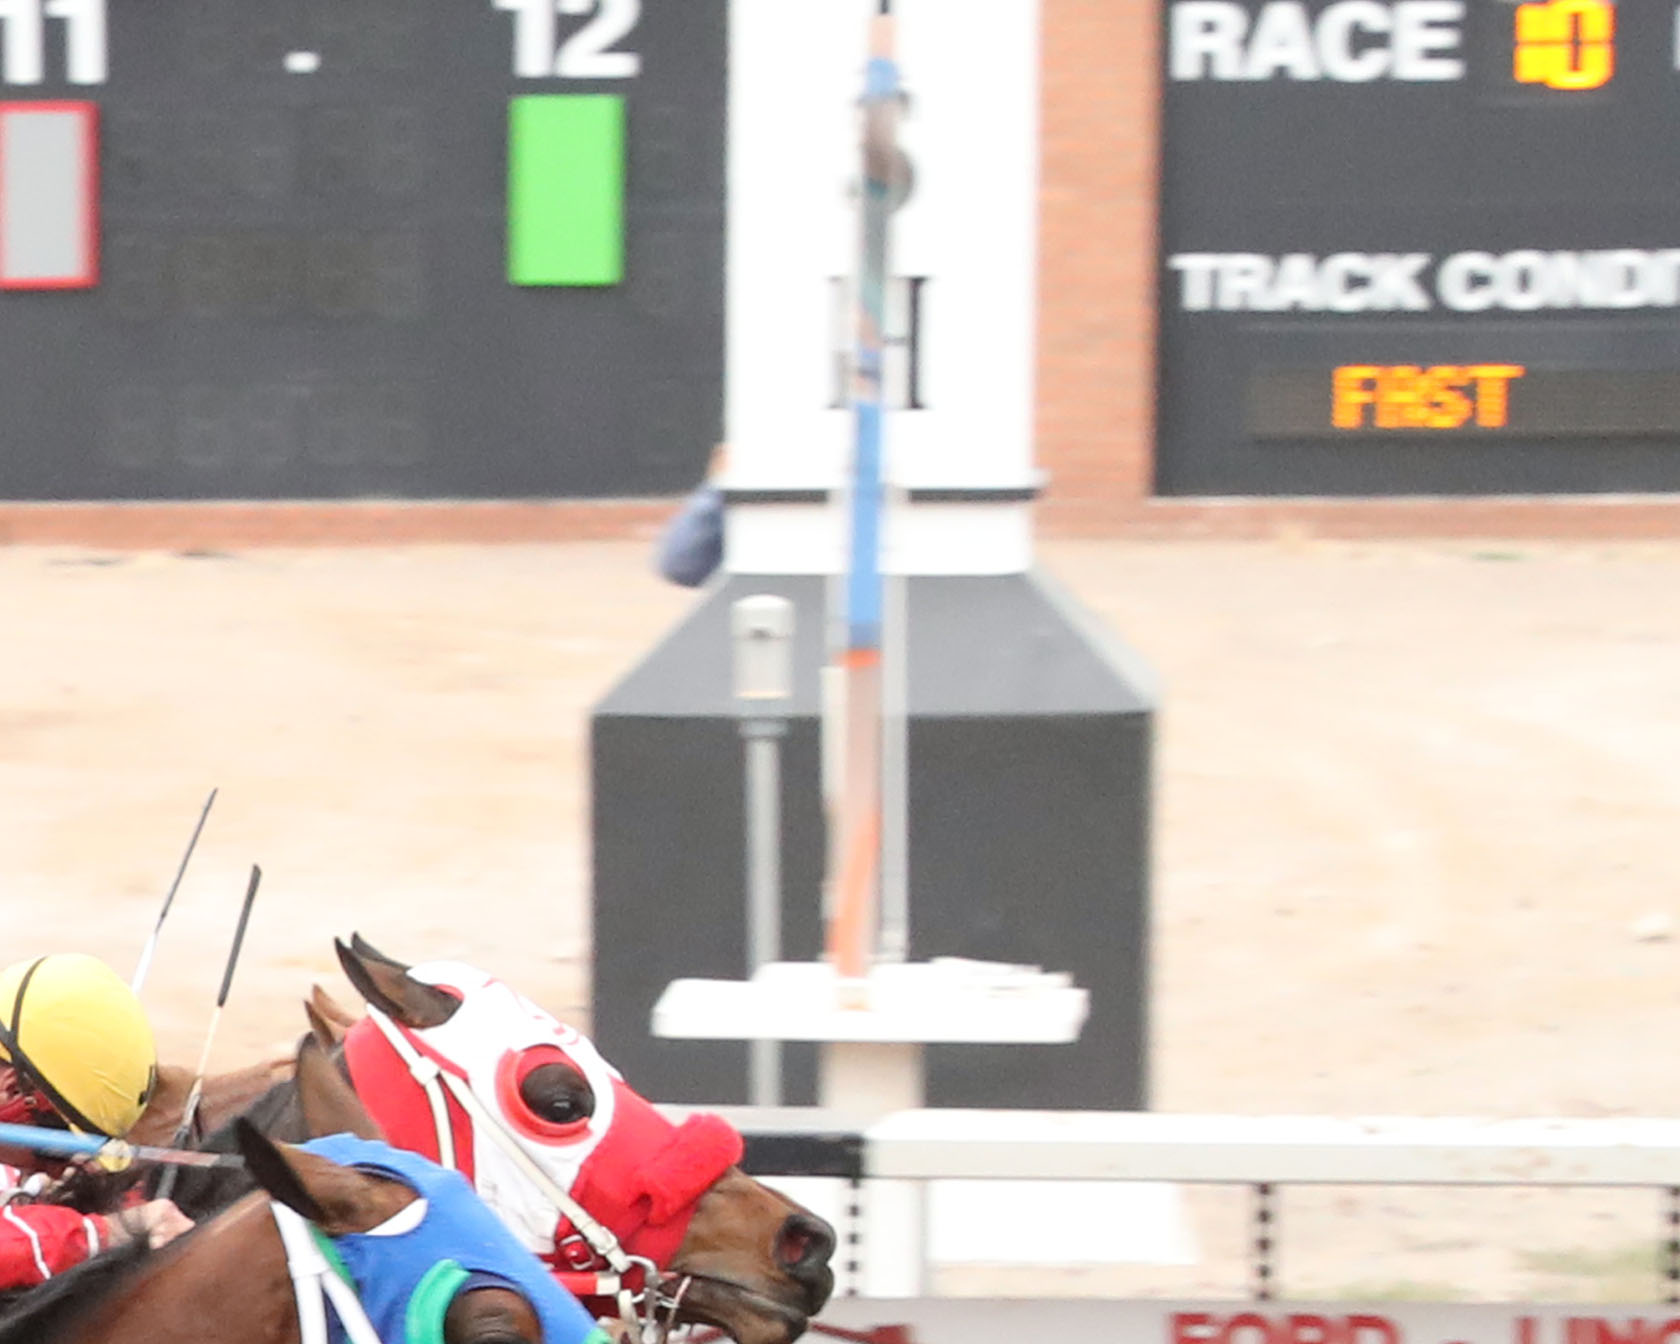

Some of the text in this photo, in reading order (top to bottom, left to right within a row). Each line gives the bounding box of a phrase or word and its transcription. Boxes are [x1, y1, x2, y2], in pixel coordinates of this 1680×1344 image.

[492, 0, 641, 79] 12
[1170, 1, 1466, 82] RACE
[1168, 252, 1432, 312] TRACK
[1332, 363, 1526, 429] FAST
